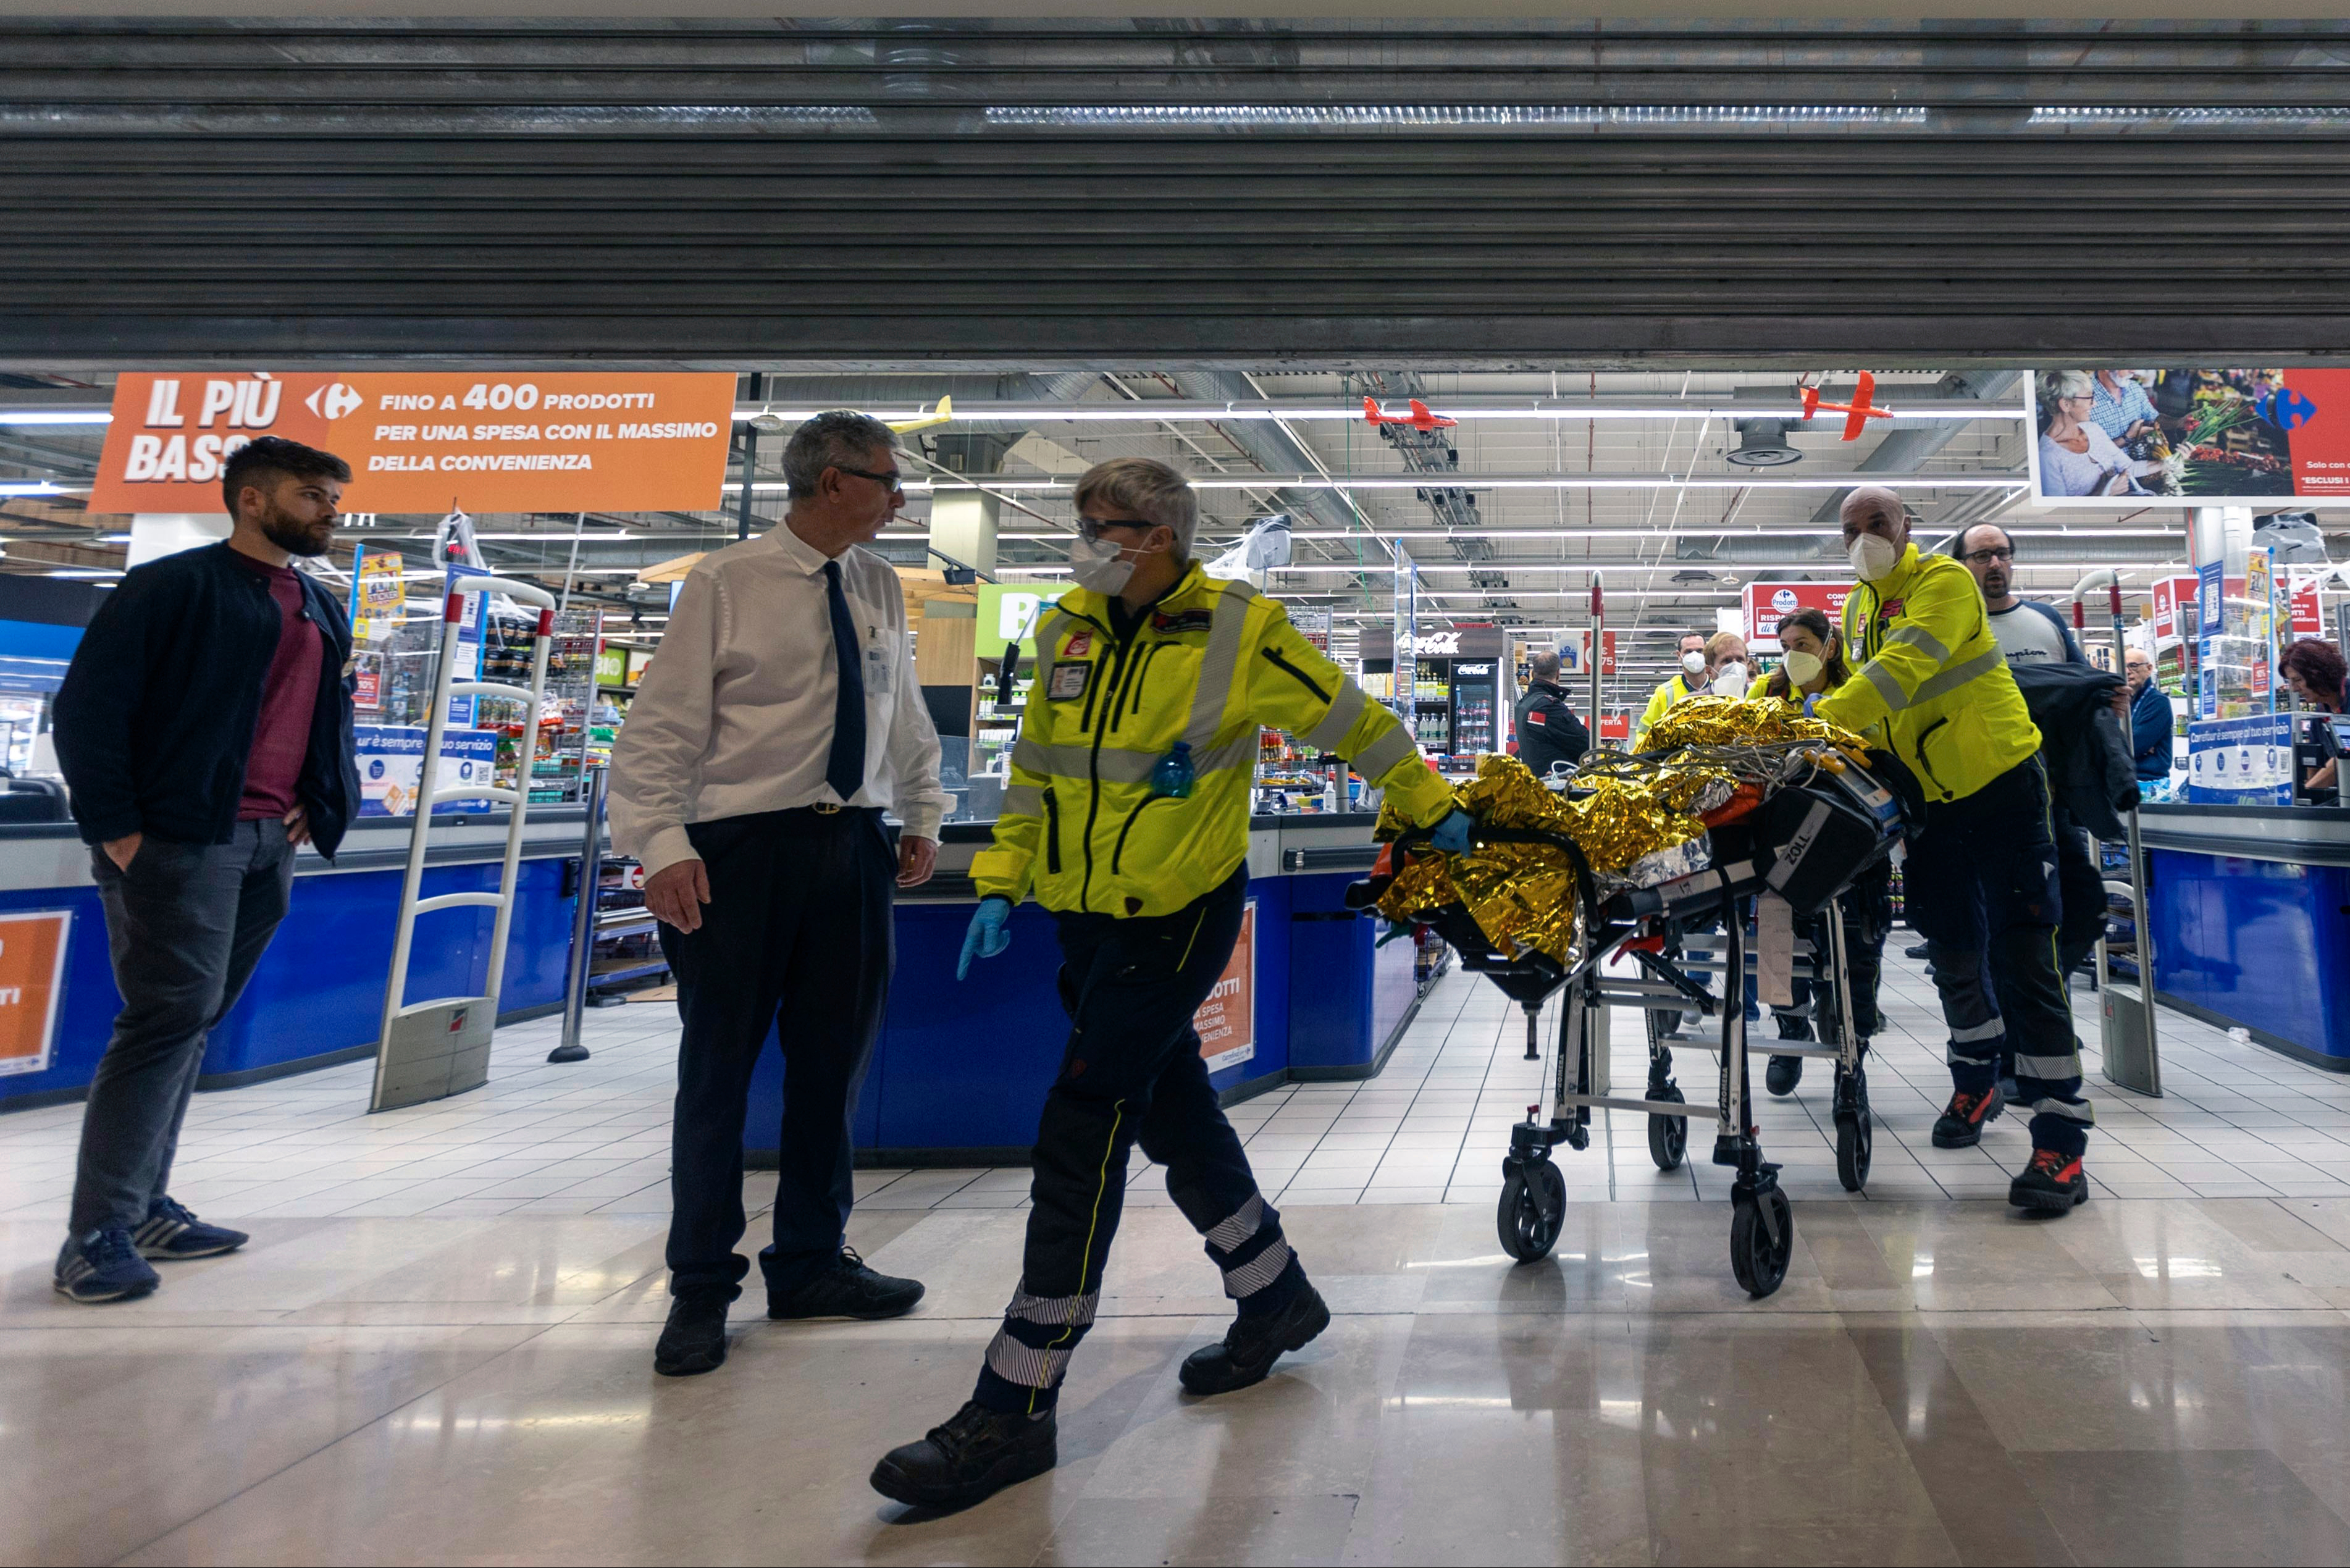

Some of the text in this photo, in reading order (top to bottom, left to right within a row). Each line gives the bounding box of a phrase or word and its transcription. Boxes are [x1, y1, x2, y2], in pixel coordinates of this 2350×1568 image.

[144, 372, 282, 429] IL PIÙ
[379, 384, 655, 411] FINO A 400 PRODOTTI
[374, 422, 718, 440] PER UNA SPESA CON IL MASSIMO
[367, 455, 592, 471] DELLA CONVENIENZA
[2306, 461, 2327, 469] Solo
[2222, 729, 2244, 742] sempre
[2251, 726, 2262, 737] tuo
[2262, 721, 2289, 736] servizio
[380, 737, 424, 751] sempre
[455, 739, 493, 750] servizio
[1785, 835, 1811, 866] ZOLL
[1202, 1002, 1224, 1017] SPESA
[1193, 1015, 1225, 1032] MASSIMO
